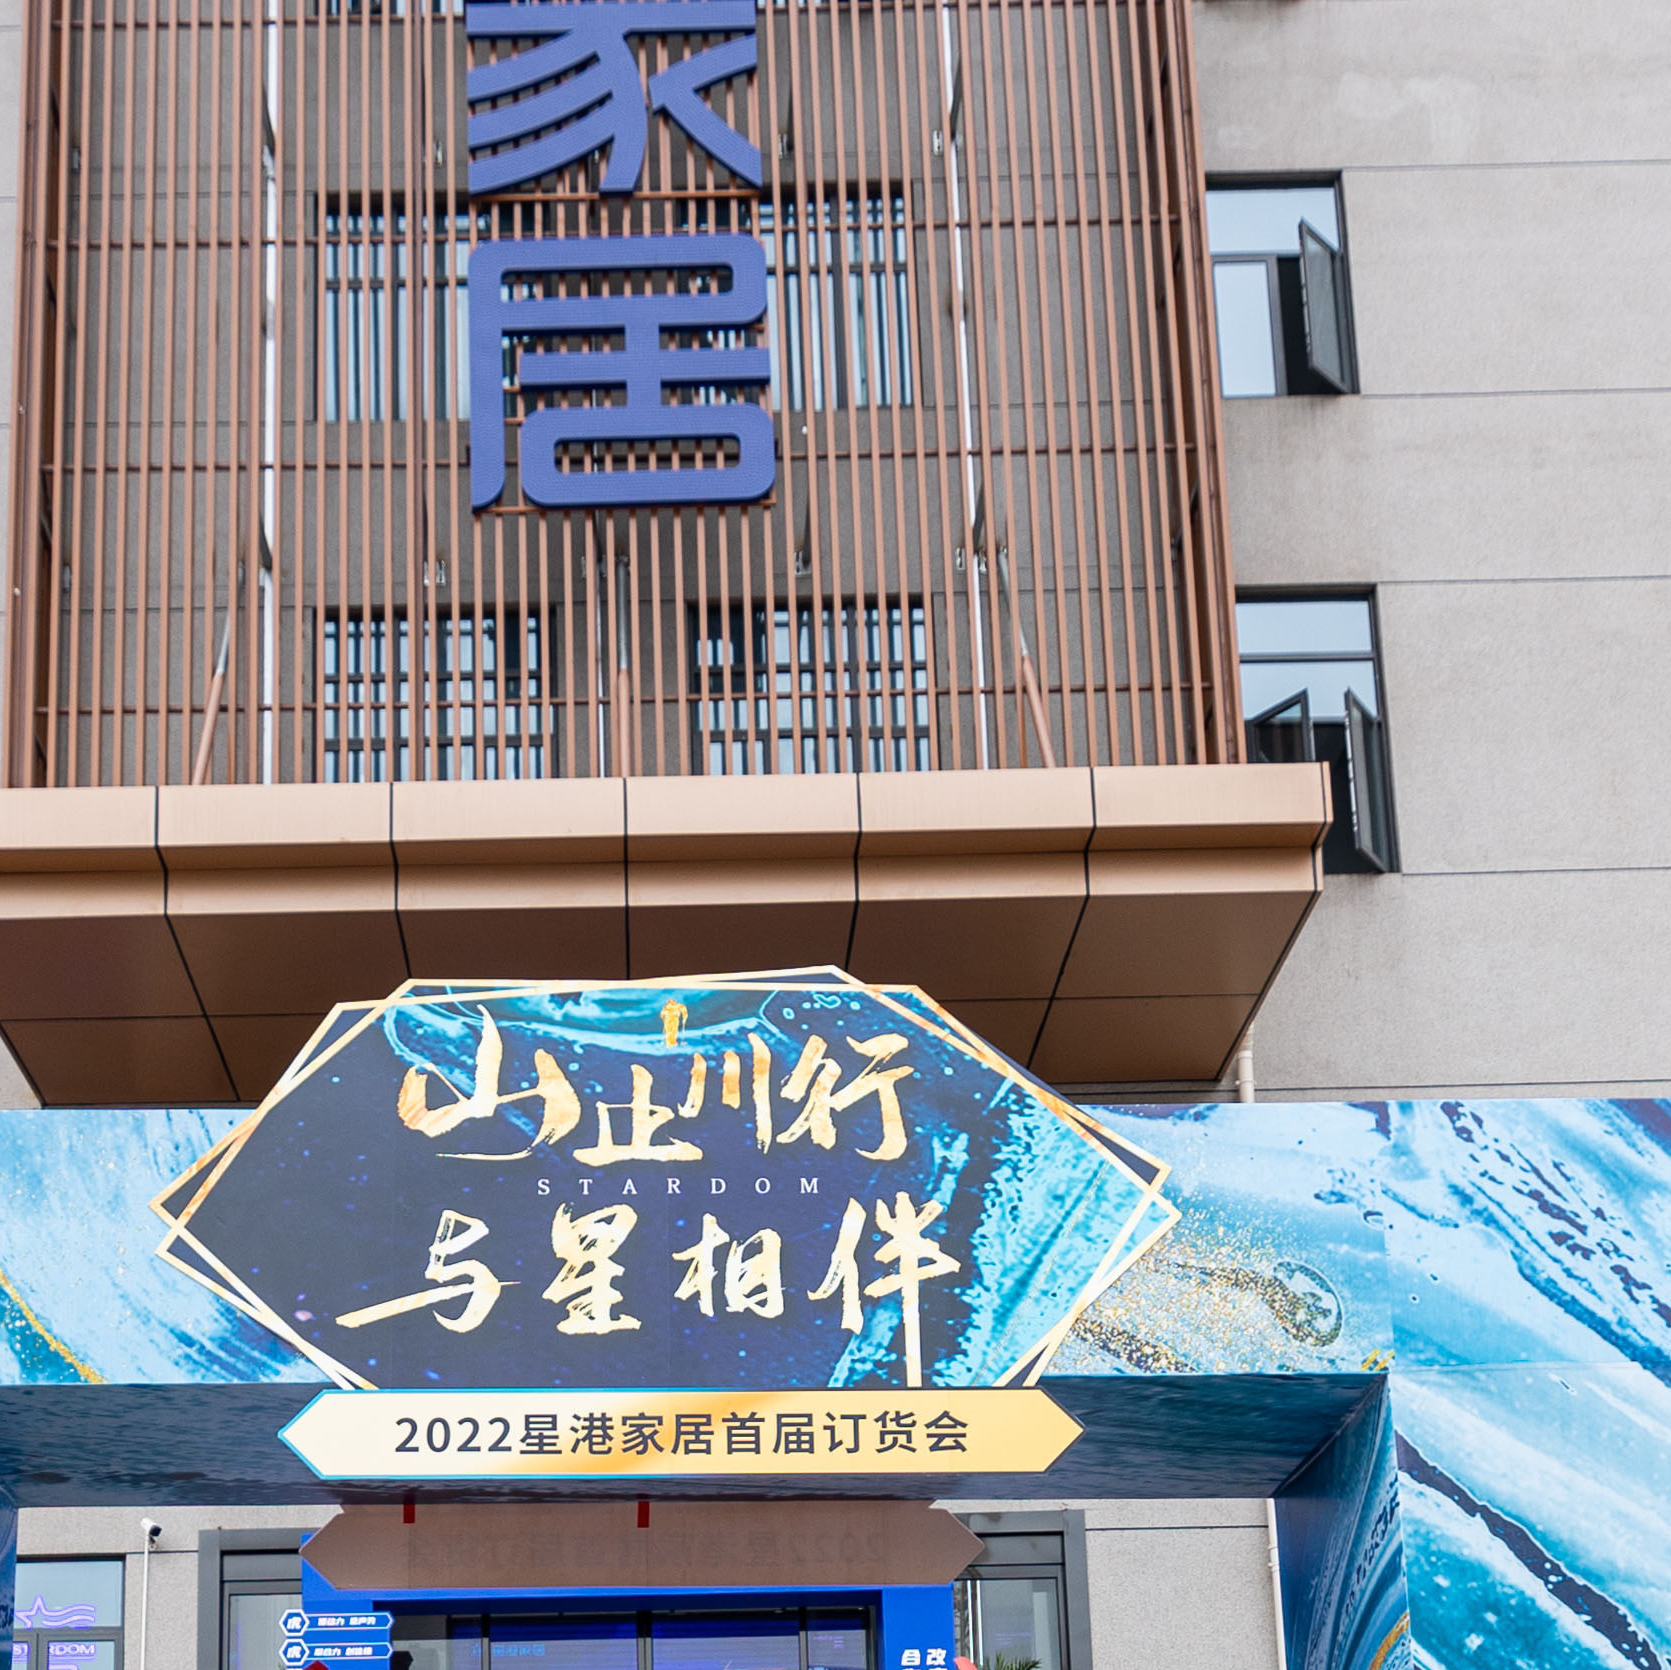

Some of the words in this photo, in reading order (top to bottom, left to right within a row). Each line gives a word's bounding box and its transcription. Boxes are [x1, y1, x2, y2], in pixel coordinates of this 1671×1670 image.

[536, 1176, 821, 1197] STARDOM
[334, 1190, 961, 1386] 与星相伴
[393, 1408, 970, 1457] 2022星港家居首届订货会
